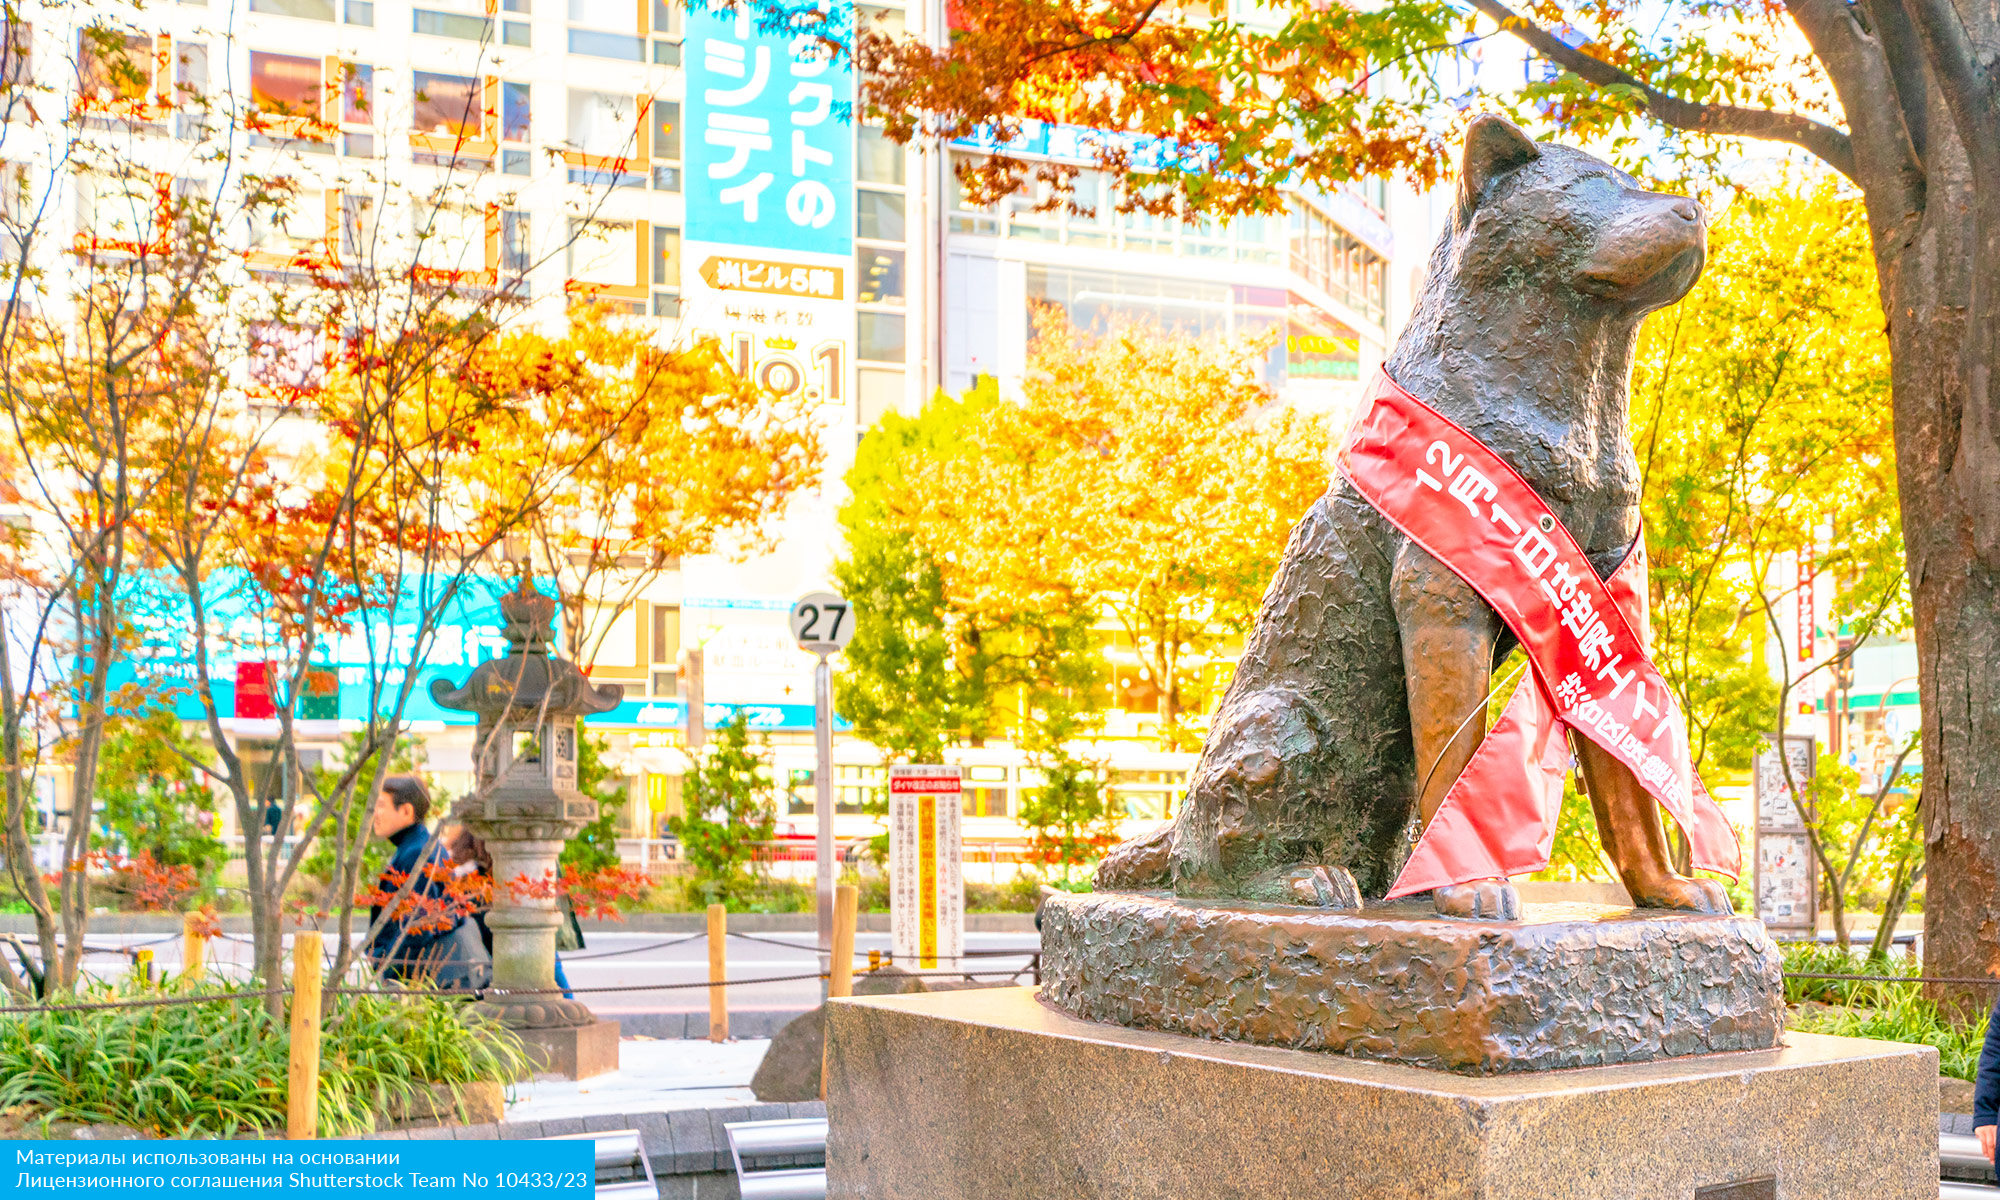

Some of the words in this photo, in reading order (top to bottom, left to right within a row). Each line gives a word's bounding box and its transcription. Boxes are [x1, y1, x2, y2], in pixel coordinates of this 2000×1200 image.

[787, 0, 837, 229] タクトの
[798, 603, 847, 641] 27
